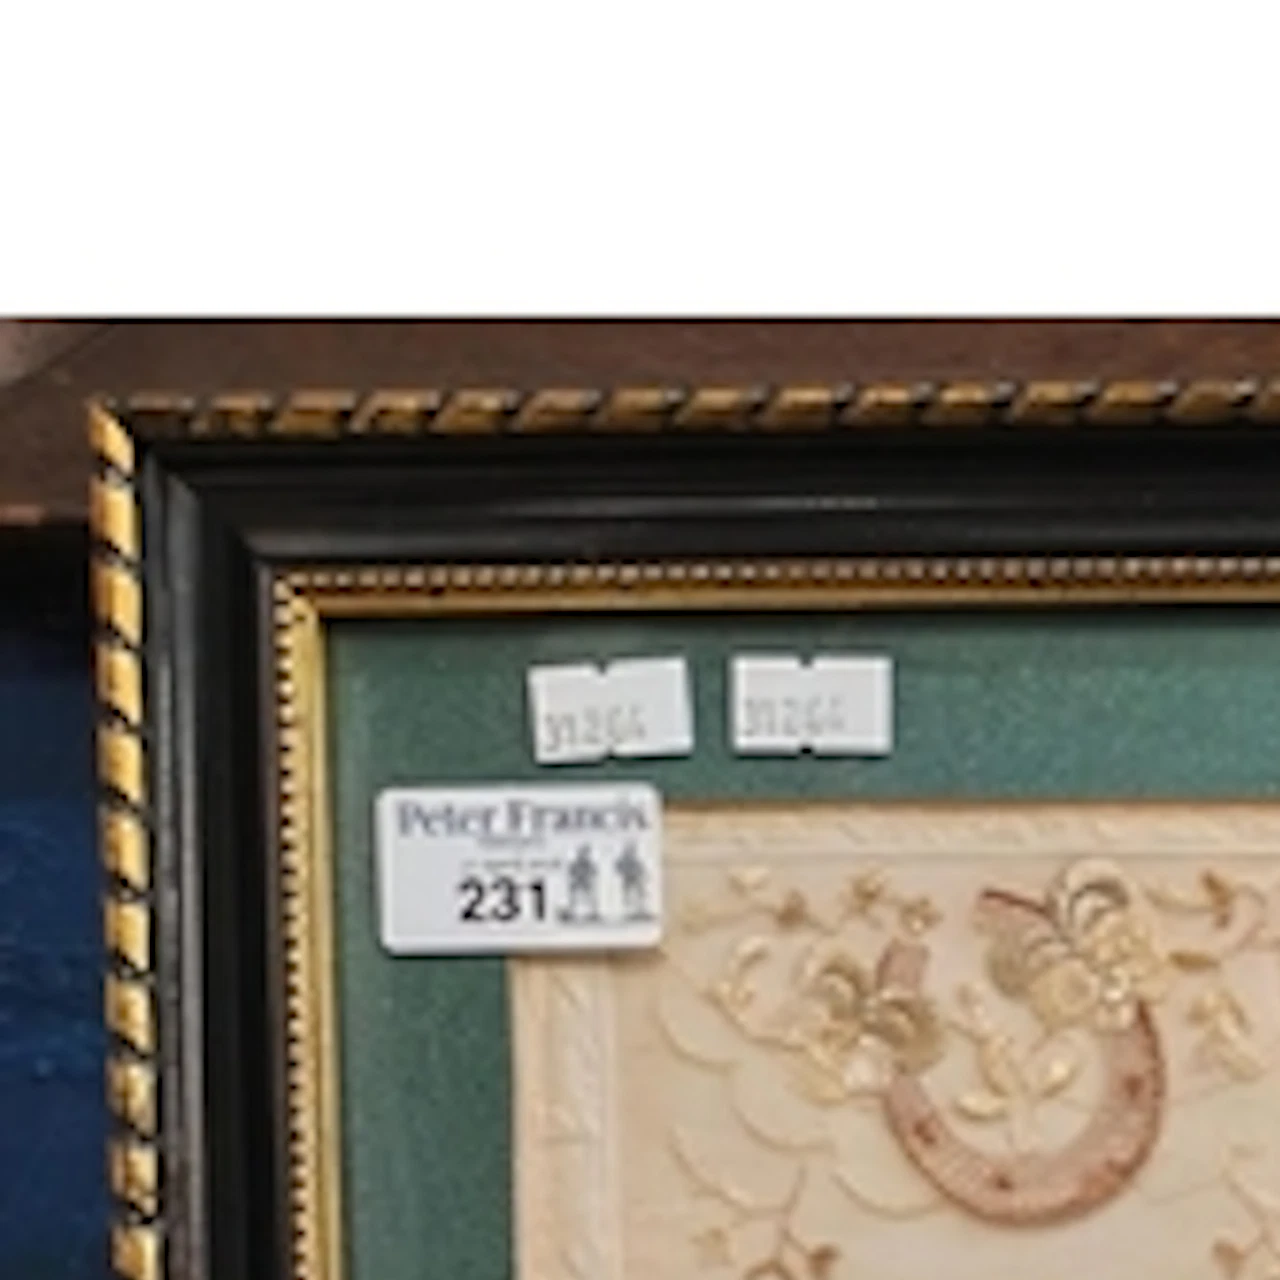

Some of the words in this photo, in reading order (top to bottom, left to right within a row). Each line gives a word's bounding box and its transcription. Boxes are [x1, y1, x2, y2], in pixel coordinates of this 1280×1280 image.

[397, 799, 495, 836] Peter
[505, 795, 651, 834] Francis
[457, 875, 546, 922] 231
